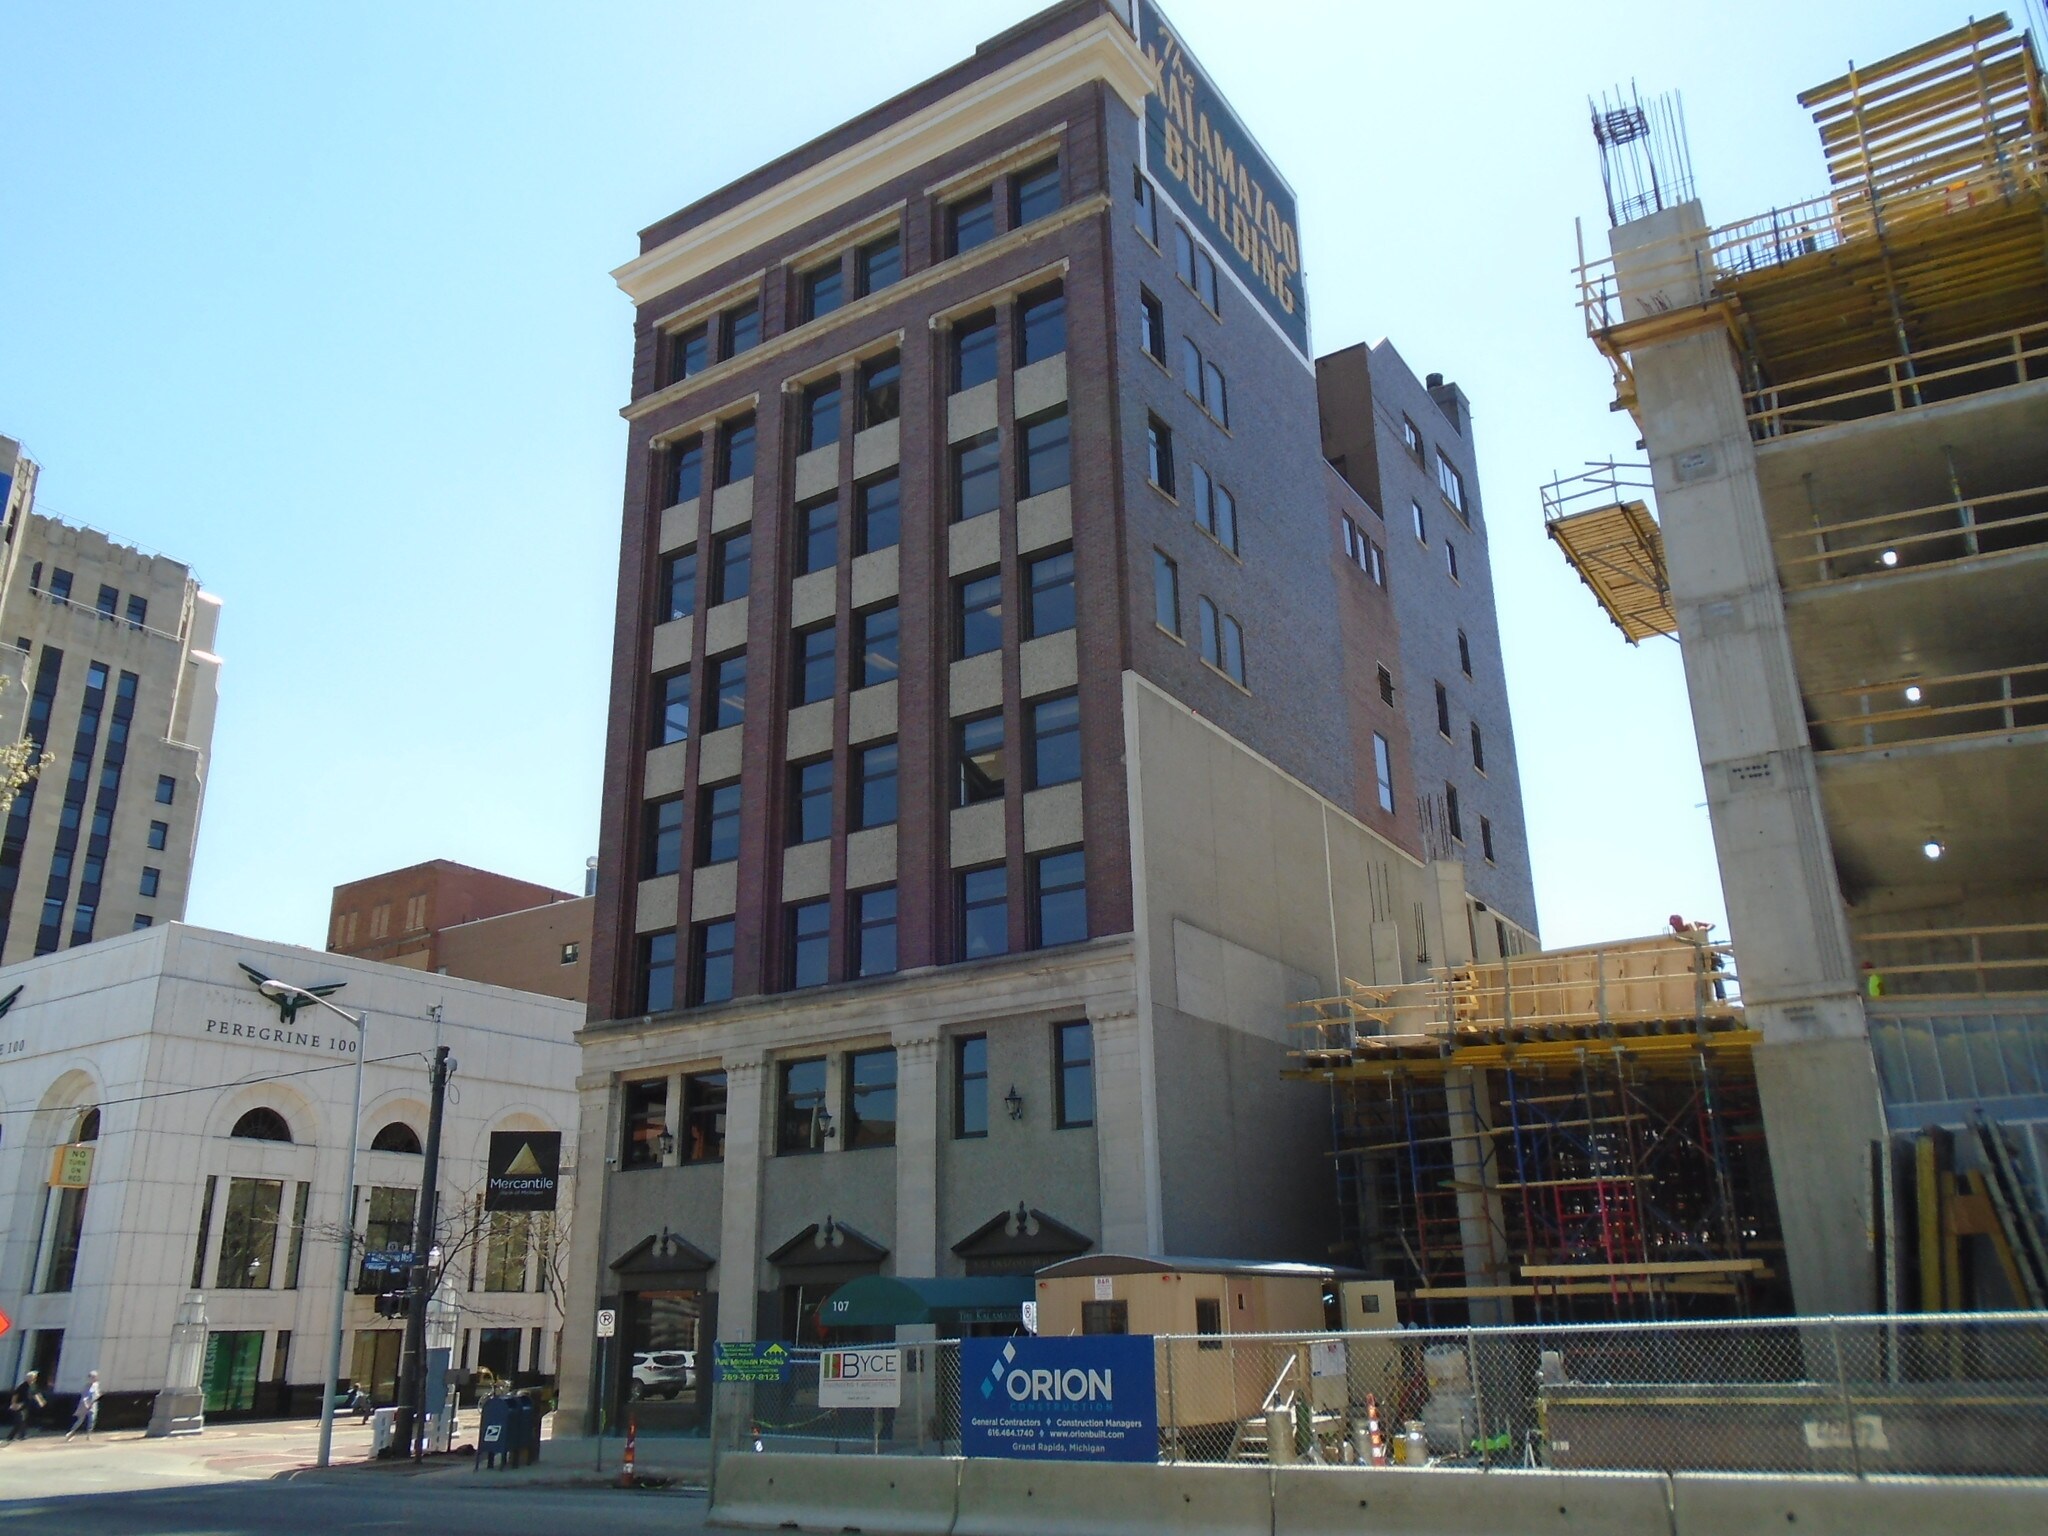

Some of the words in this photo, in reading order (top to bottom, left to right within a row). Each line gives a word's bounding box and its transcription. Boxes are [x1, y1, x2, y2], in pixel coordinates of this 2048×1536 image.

[1158, 26, 1194, 92] The
[1148, 42, 1297, 272] KALAMAZOO
[1164, 116, 1293, 315] BUILDING
[206, 1019, 321, 1048] PEREGRINE
[330, 1038, 356, 1053] 100
[7, 1040, 25, 1053] 100
[72, 1150, 86, 1158] NO
[490, 1177, 553, 1189] Mercantile
[832, 1301, 849, 1312] 107
[842, 1353, 896, 1378] BYCE
[1006, 1368, 1113, 1401] ORION
[1010, 1402, 1113, 1412] CONSTRUCTION
[972, 1417, 998, 1426] General
[1000, 1417, 1041, 1427] Contractors
[1056, 1418, 1103, 1427] Construction
[1105, 1419, 1142, 1429] Managers
[1050, 1430, 1125, 1439] www.orionbuilt.com
[1012, 1442, 1036, 1451] Grand
[1038, 1443, 1067, 1453] Rapids,
[1069, 1443, 1105, 1454] Michigan
